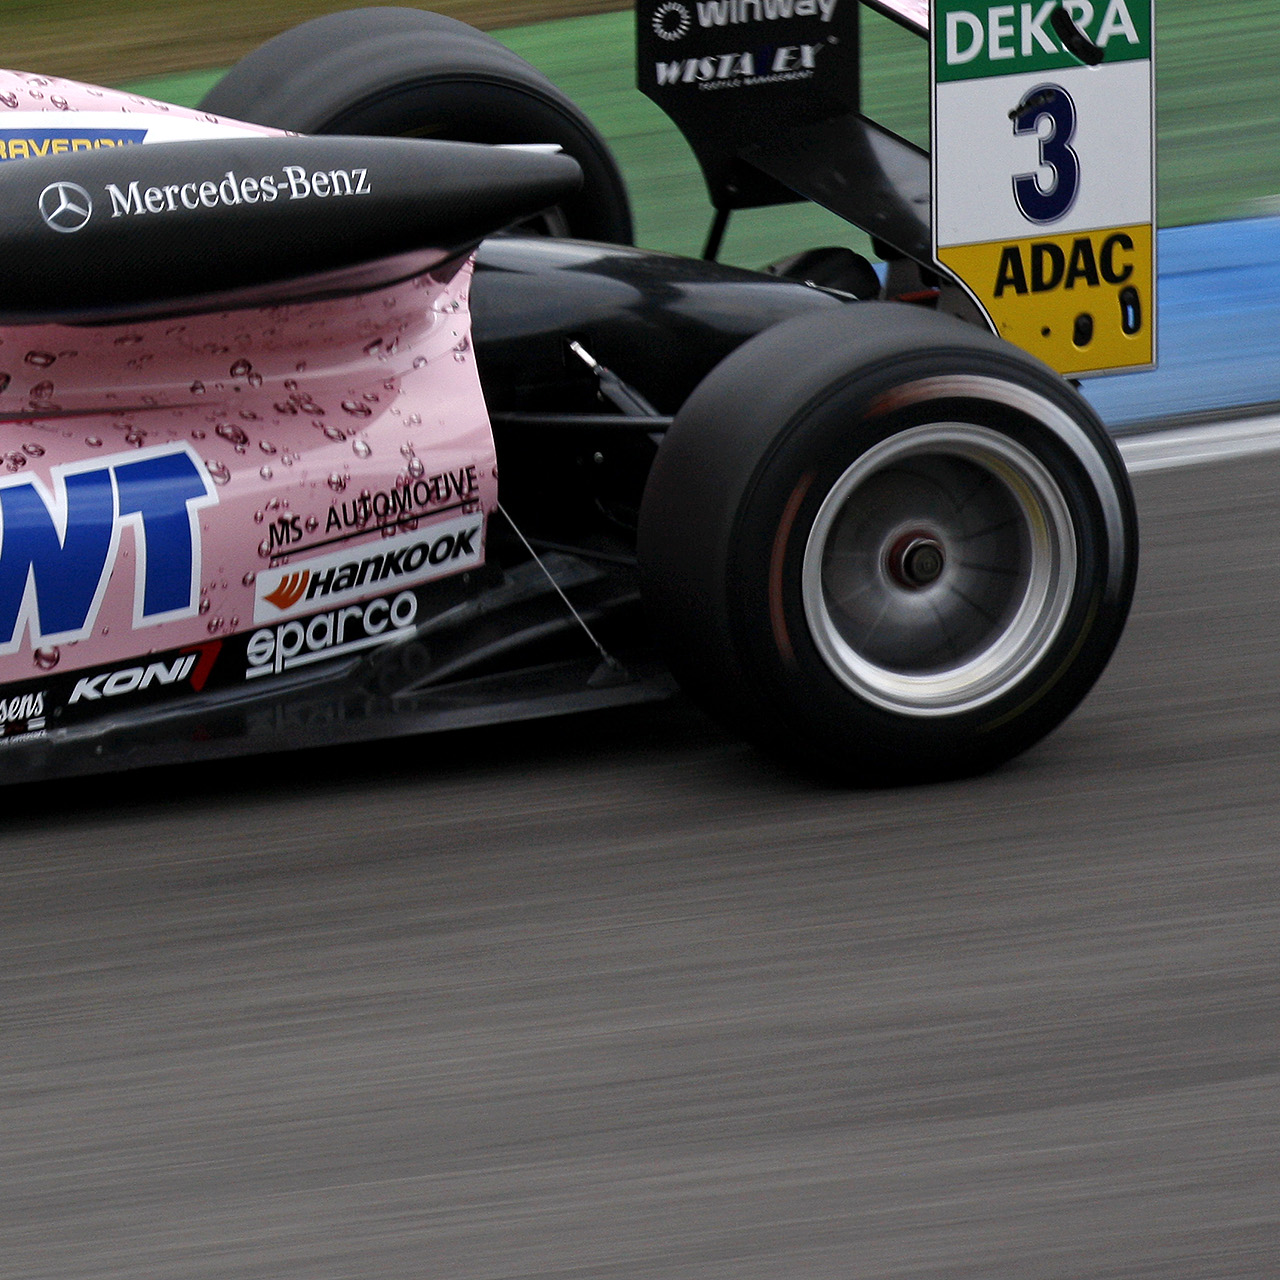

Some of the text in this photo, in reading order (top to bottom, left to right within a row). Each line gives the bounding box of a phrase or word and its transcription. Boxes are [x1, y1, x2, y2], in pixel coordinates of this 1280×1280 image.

[1011, 82, 1079, 225] 3
[105, 165, 371, 218] Mercedes-Benz
[993, 232, 1134, 298] ADAC
[326, 465, 479, 535] AUTOMOTIVE
[247, 591, 418, 674] sparco
[68, 654, 197, 705] KONI
